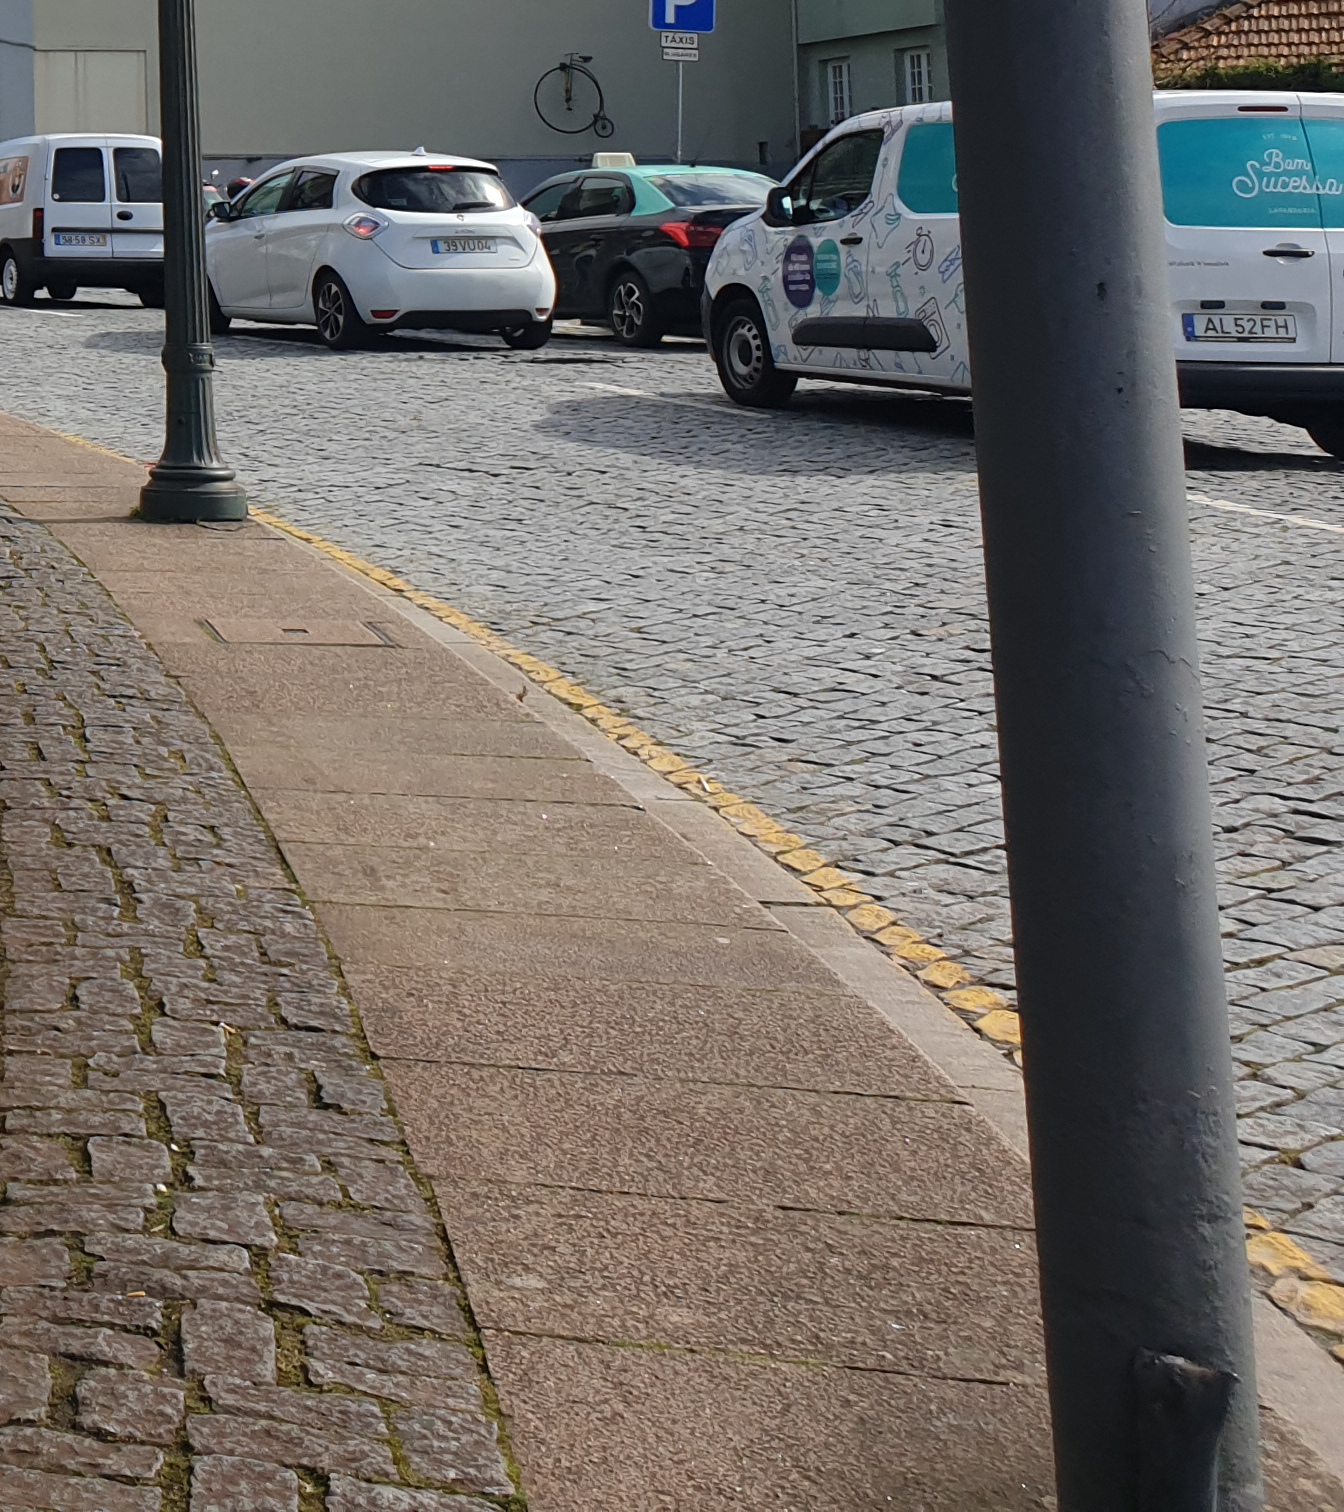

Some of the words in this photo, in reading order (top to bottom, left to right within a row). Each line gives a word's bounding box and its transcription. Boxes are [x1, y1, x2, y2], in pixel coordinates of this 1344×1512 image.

[664, 33, 695, 45] TÁXIS
[1261, 148, 1312, 173] Bom
[1231, 160, 1344, 198] Sucesso
